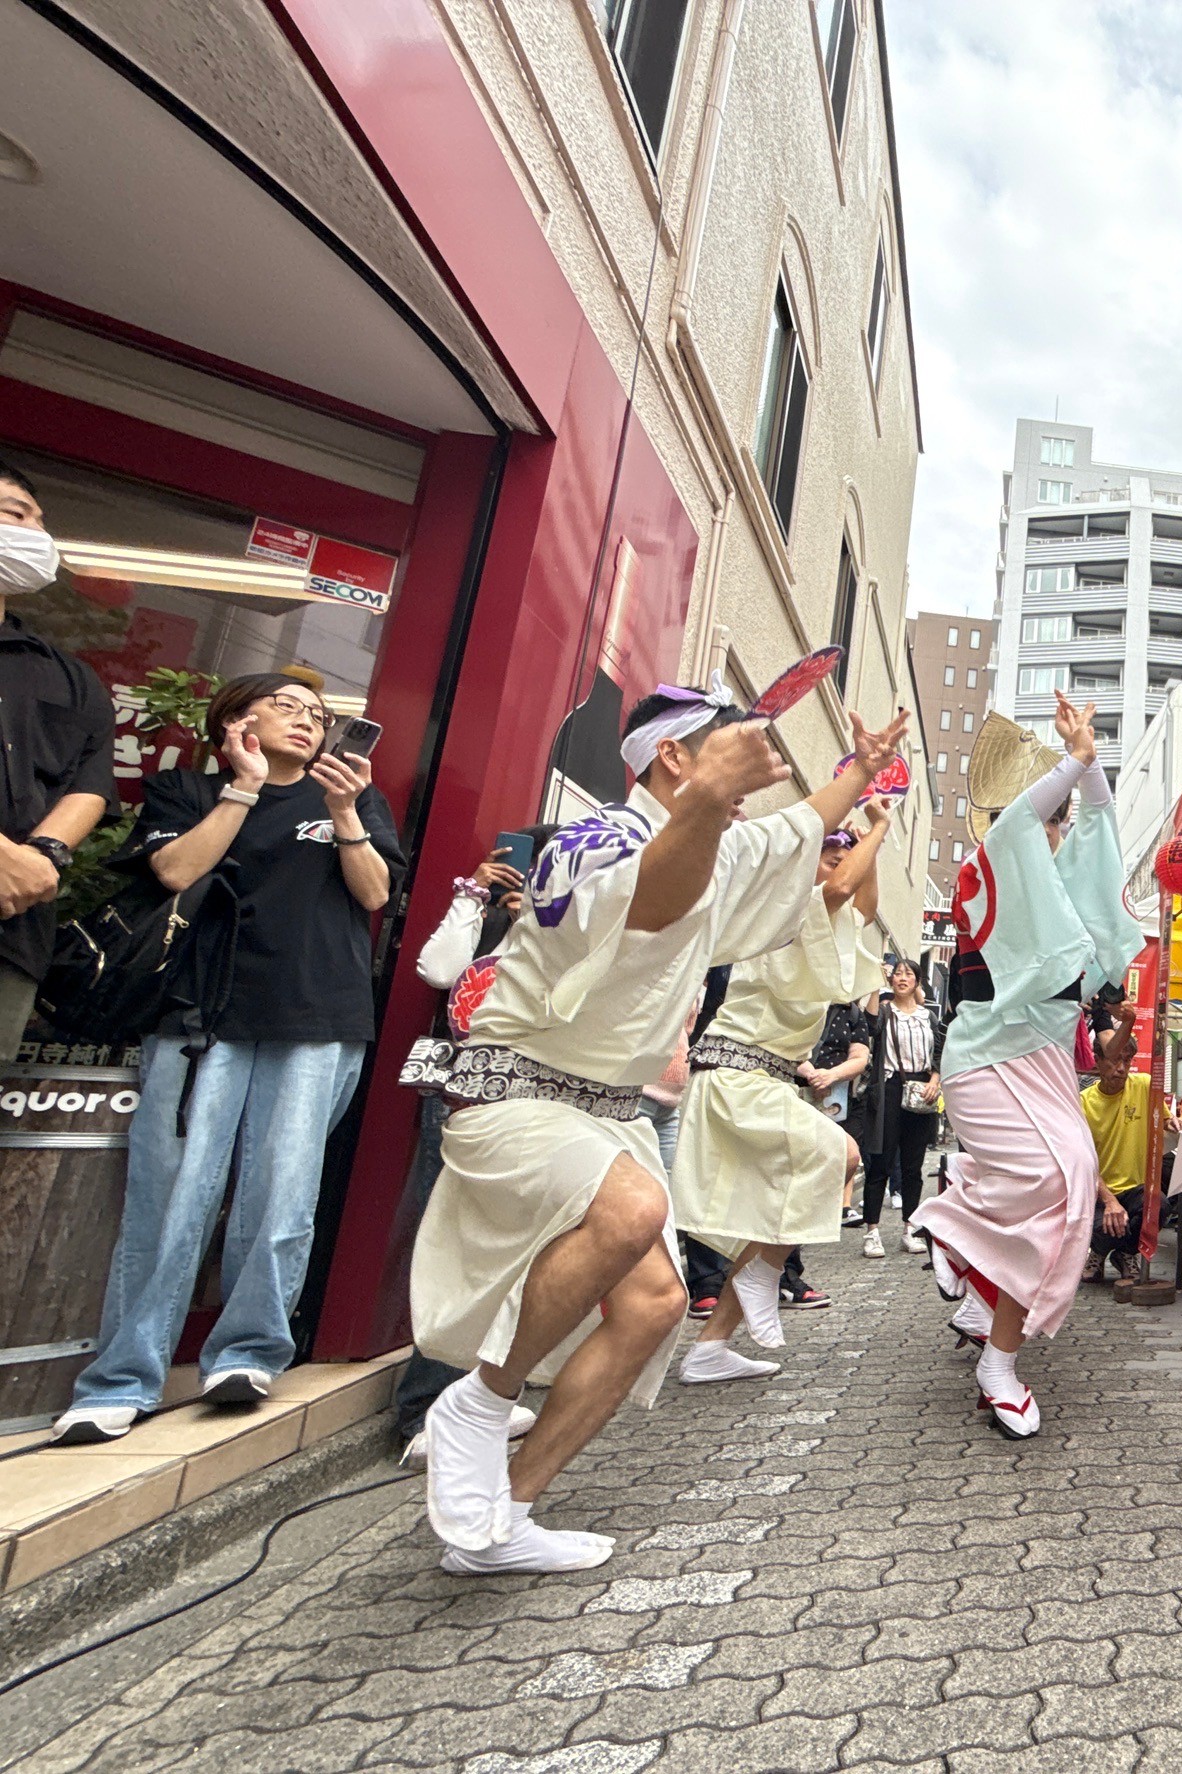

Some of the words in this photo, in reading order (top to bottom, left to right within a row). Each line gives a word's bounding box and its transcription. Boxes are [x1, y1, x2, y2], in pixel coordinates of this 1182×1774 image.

[336, 569, 365, 583] Security
[309, 577, 383, 607] SECOM
[0, 1087, 107, 1119] quor
